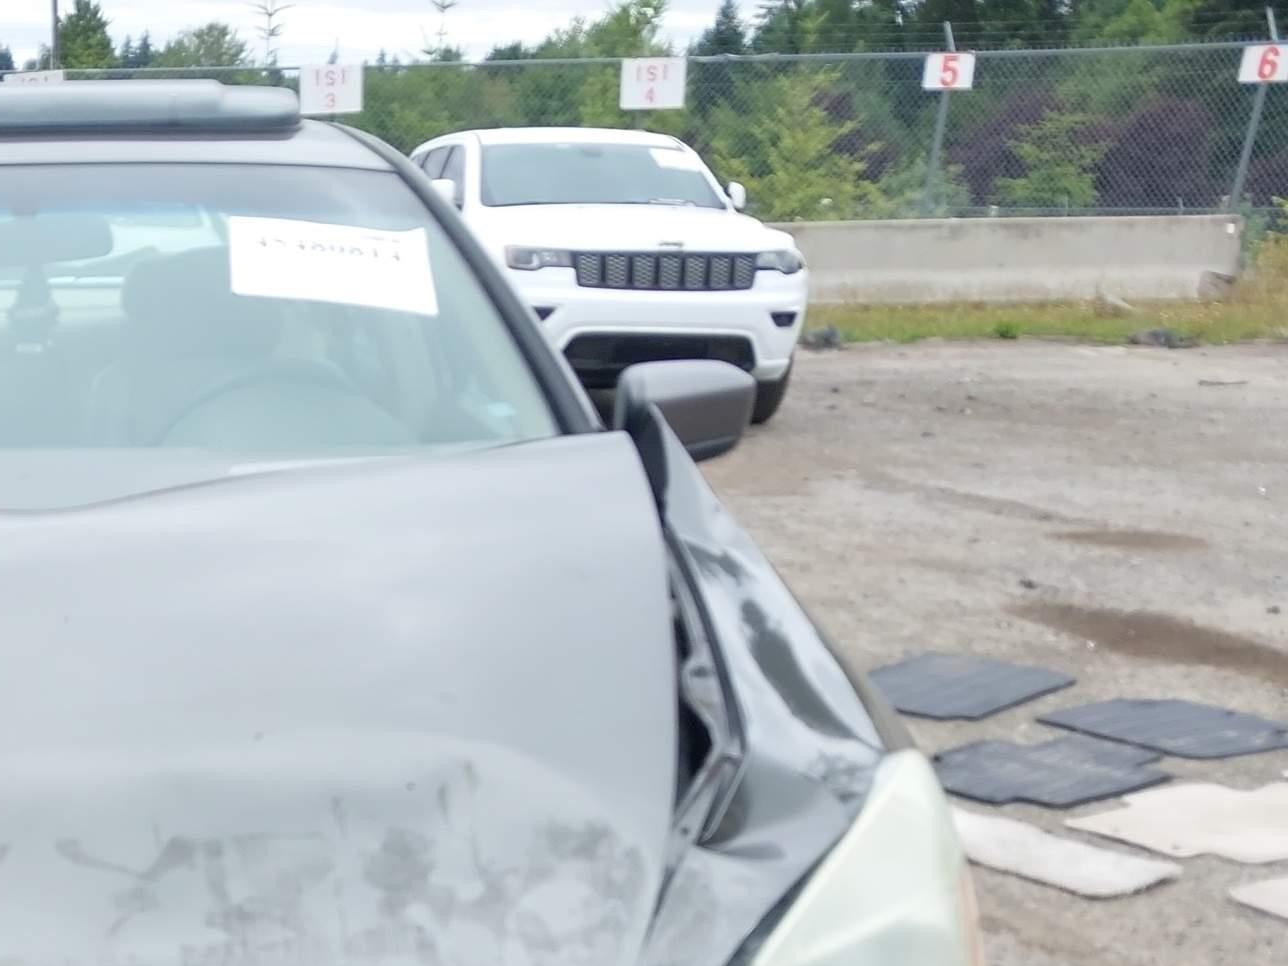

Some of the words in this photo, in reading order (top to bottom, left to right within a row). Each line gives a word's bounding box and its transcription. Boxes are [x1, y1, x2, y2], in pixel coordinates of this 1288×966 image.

[940, 55, 959, 86] 5
[1257, 46, 1280, 80] 6
[645, 87, 655, 104] 4
